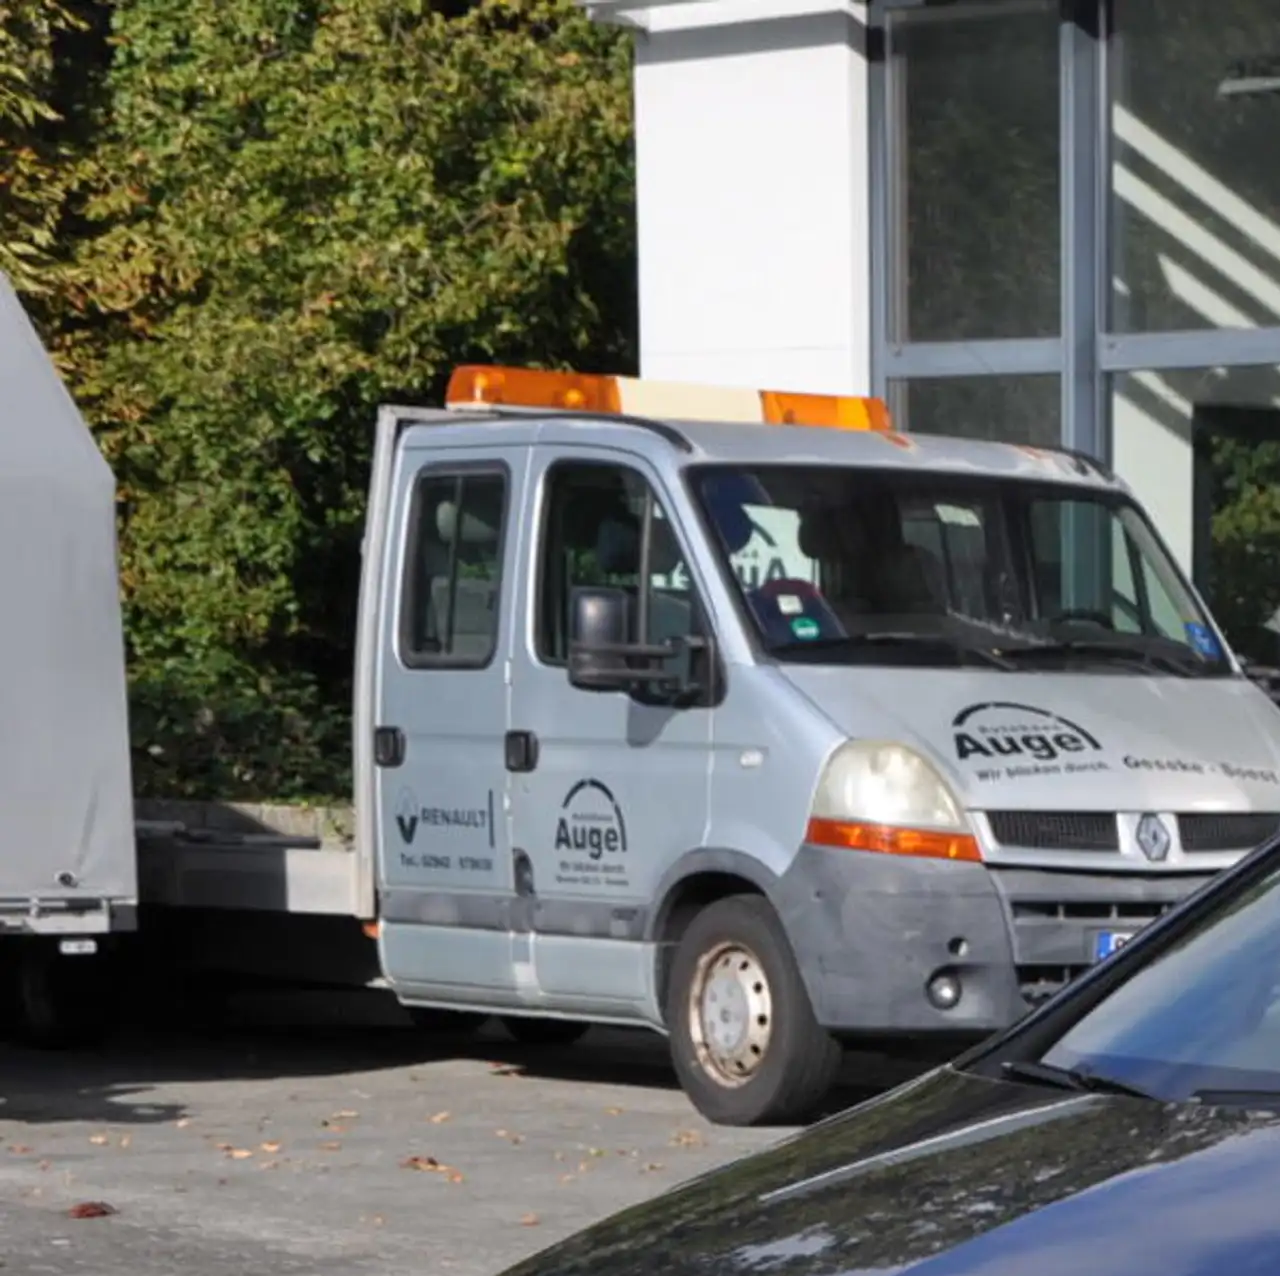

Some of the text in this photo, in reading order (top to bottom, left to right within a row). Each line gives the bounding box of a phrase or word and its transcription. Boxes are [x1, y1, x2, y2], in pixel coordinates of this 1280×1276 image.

[954, 718, 1103, 761] Augel
[421, 806, 487, 829] RENAULT
[554, 812, 628, 861] Augel
